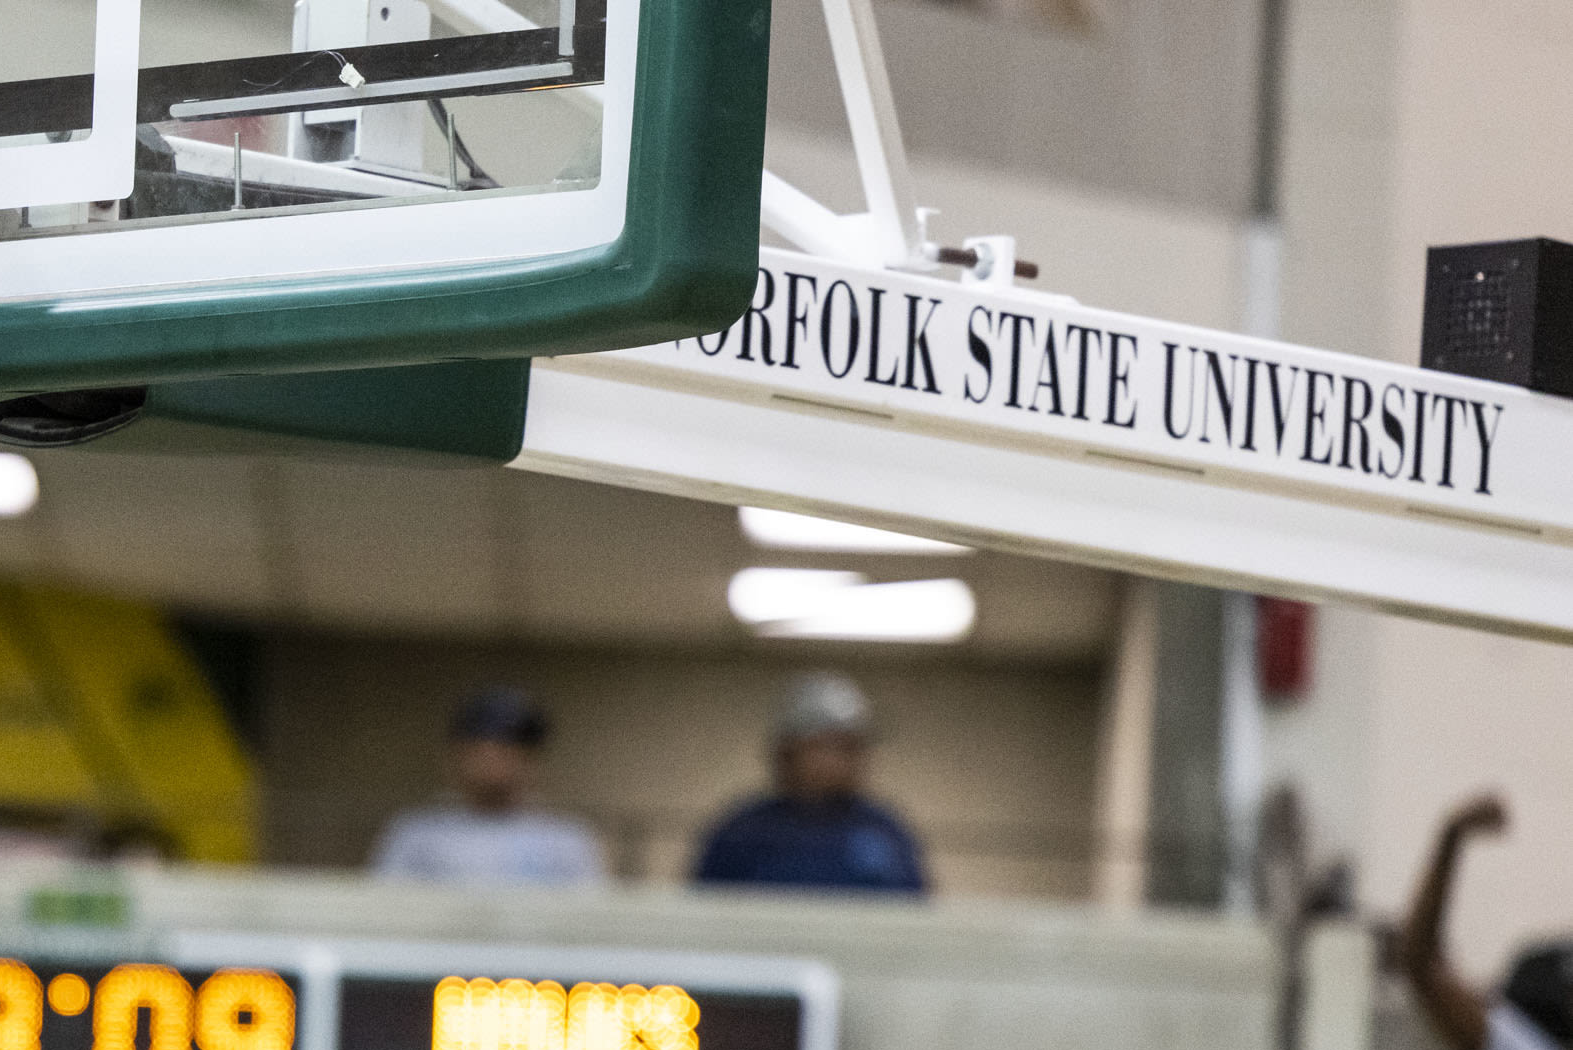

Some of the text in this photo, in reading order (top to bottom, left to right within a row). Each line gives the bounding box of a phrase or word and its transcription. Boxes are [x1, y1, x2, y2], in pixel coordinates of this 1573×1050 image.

[676, 267, 1505, 497] RFOLK STATE UNIVERSITY
